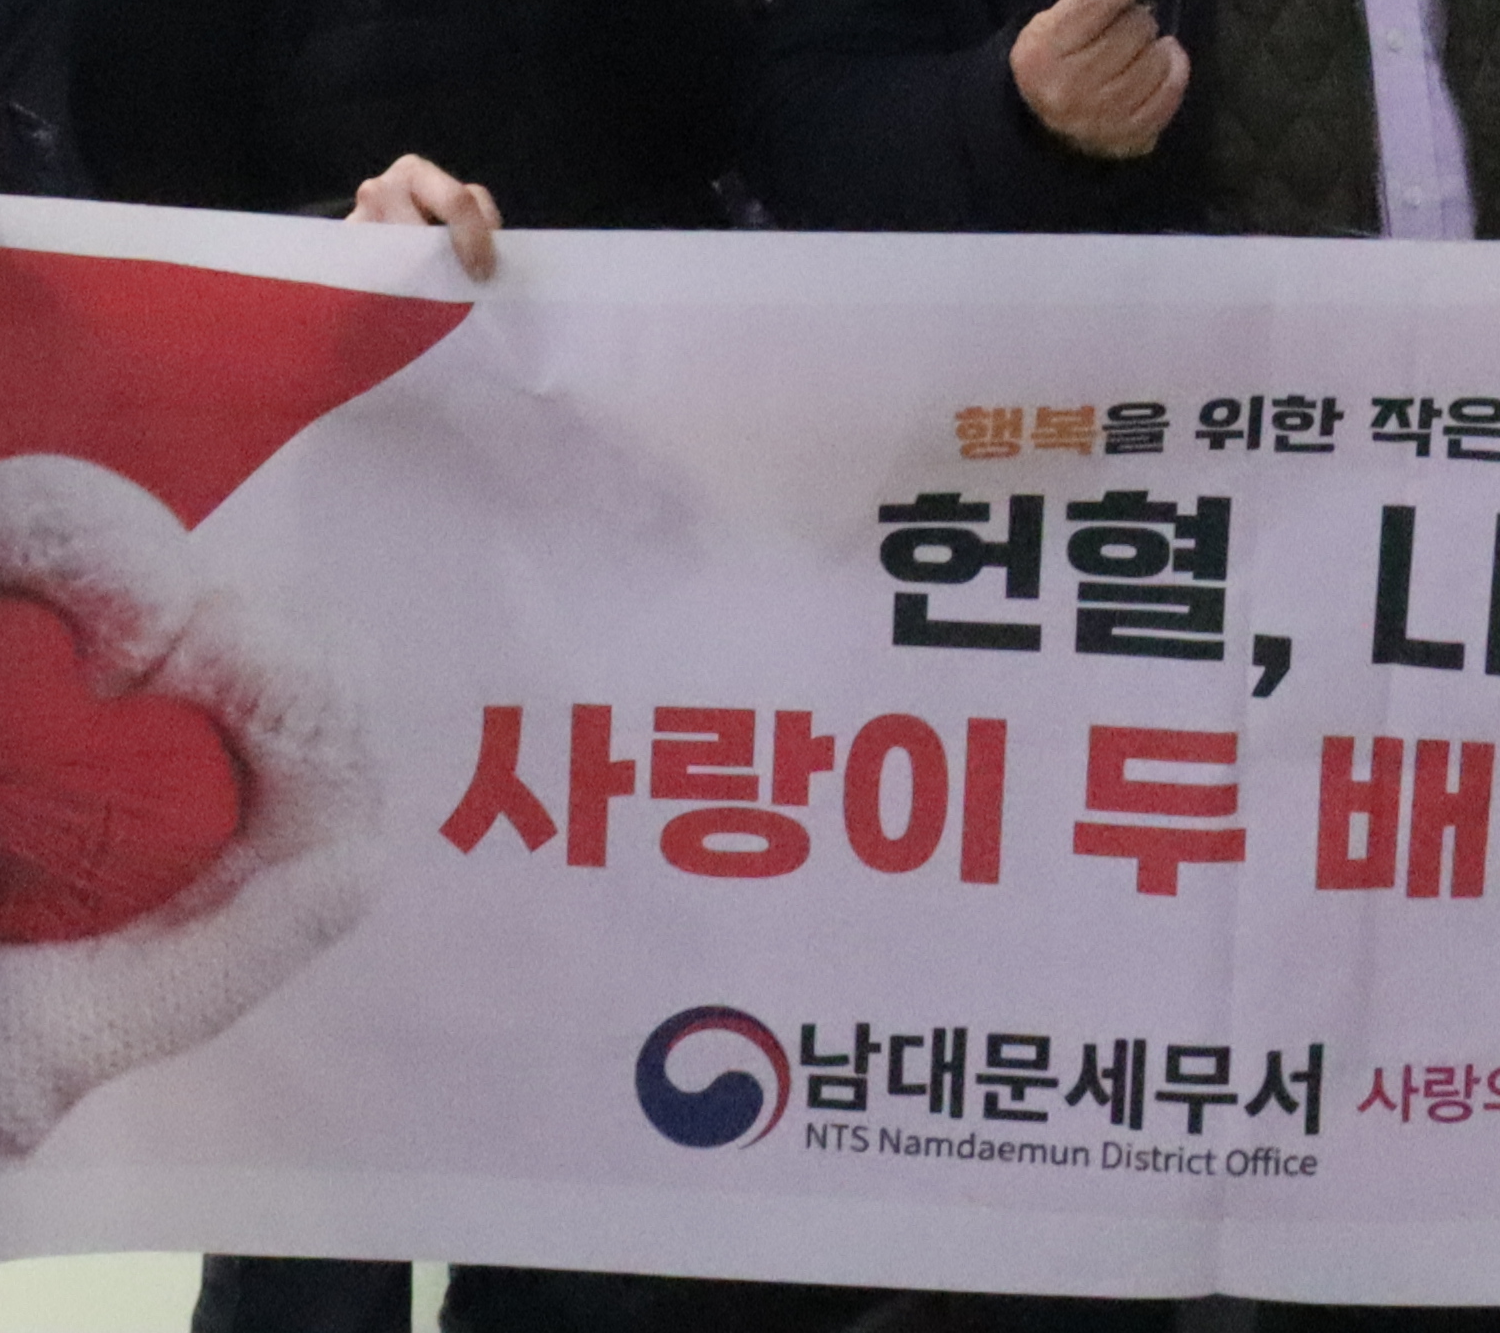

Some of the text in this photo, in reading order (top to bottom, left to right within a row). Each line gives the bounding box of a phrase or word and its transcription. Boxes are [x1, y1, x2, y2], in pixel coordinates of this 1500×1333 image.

[955, 401, 1171, 461] 행복을
[1194, 394, 1345, 454] 위한
[877, 489, 1292, 699] 헌혈,
[438, 703, 1008, 885] 사랑이
[1072, 724, 1247, 897] 두
[799, 1022, 1325, 1136] 남대문세무서
[805, 1122, 1319, 1178] NTS Namdaemun District Office
